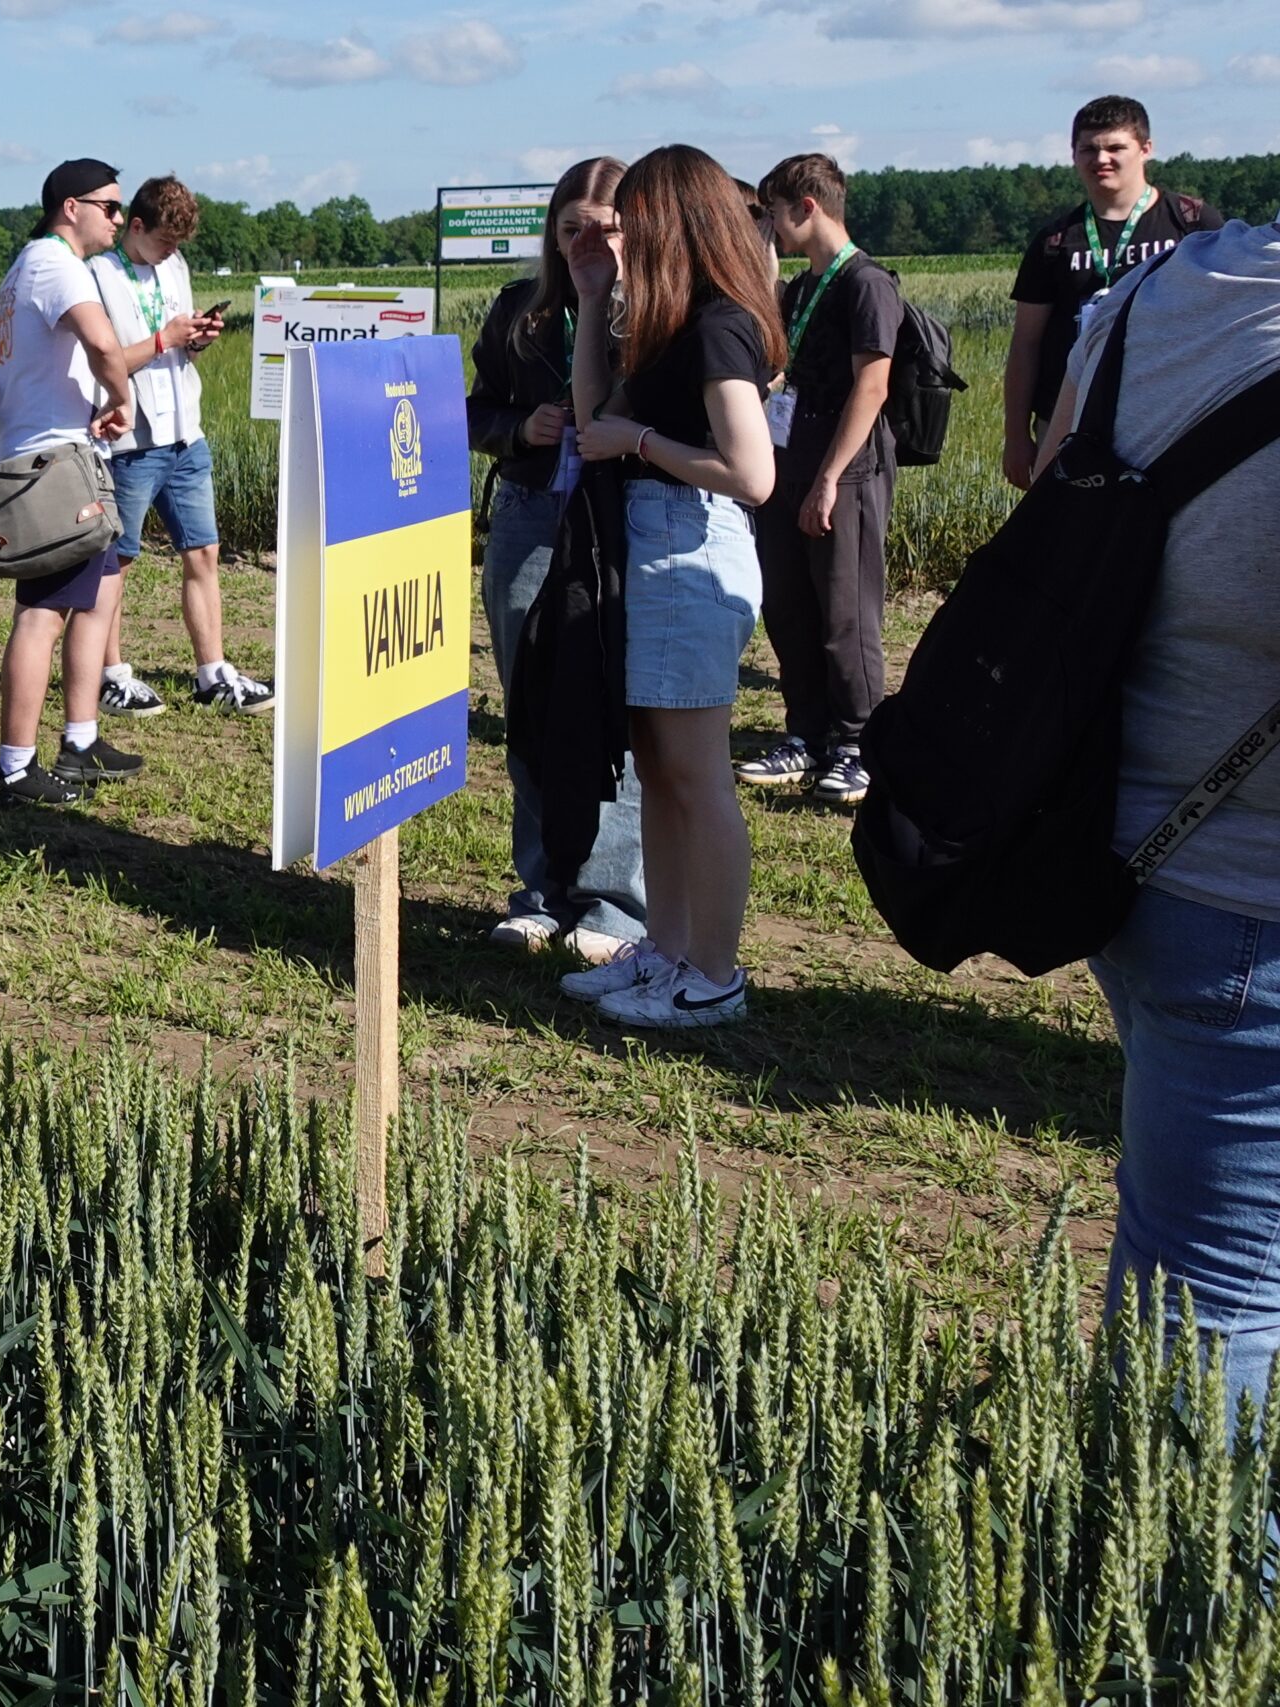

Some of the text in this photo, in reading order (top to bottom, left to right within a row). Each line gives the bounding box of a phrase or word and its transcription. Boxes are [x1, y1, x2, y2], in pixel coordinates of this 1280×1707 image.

[448, 216, 546, 227] DOŚWIADCZALNICTW
[464, 208, 537, 217] POREJESTROWE
[471, 226, 529, 235] ODMIANOWE
[284, 321, 379, 342] Kamrat
[390, 421, 422, 480] STRZELCE
[363, 570, 444, 677] VANILIA
[344, 744, 451, 822] WWW.HR-STRZELCE.PL
